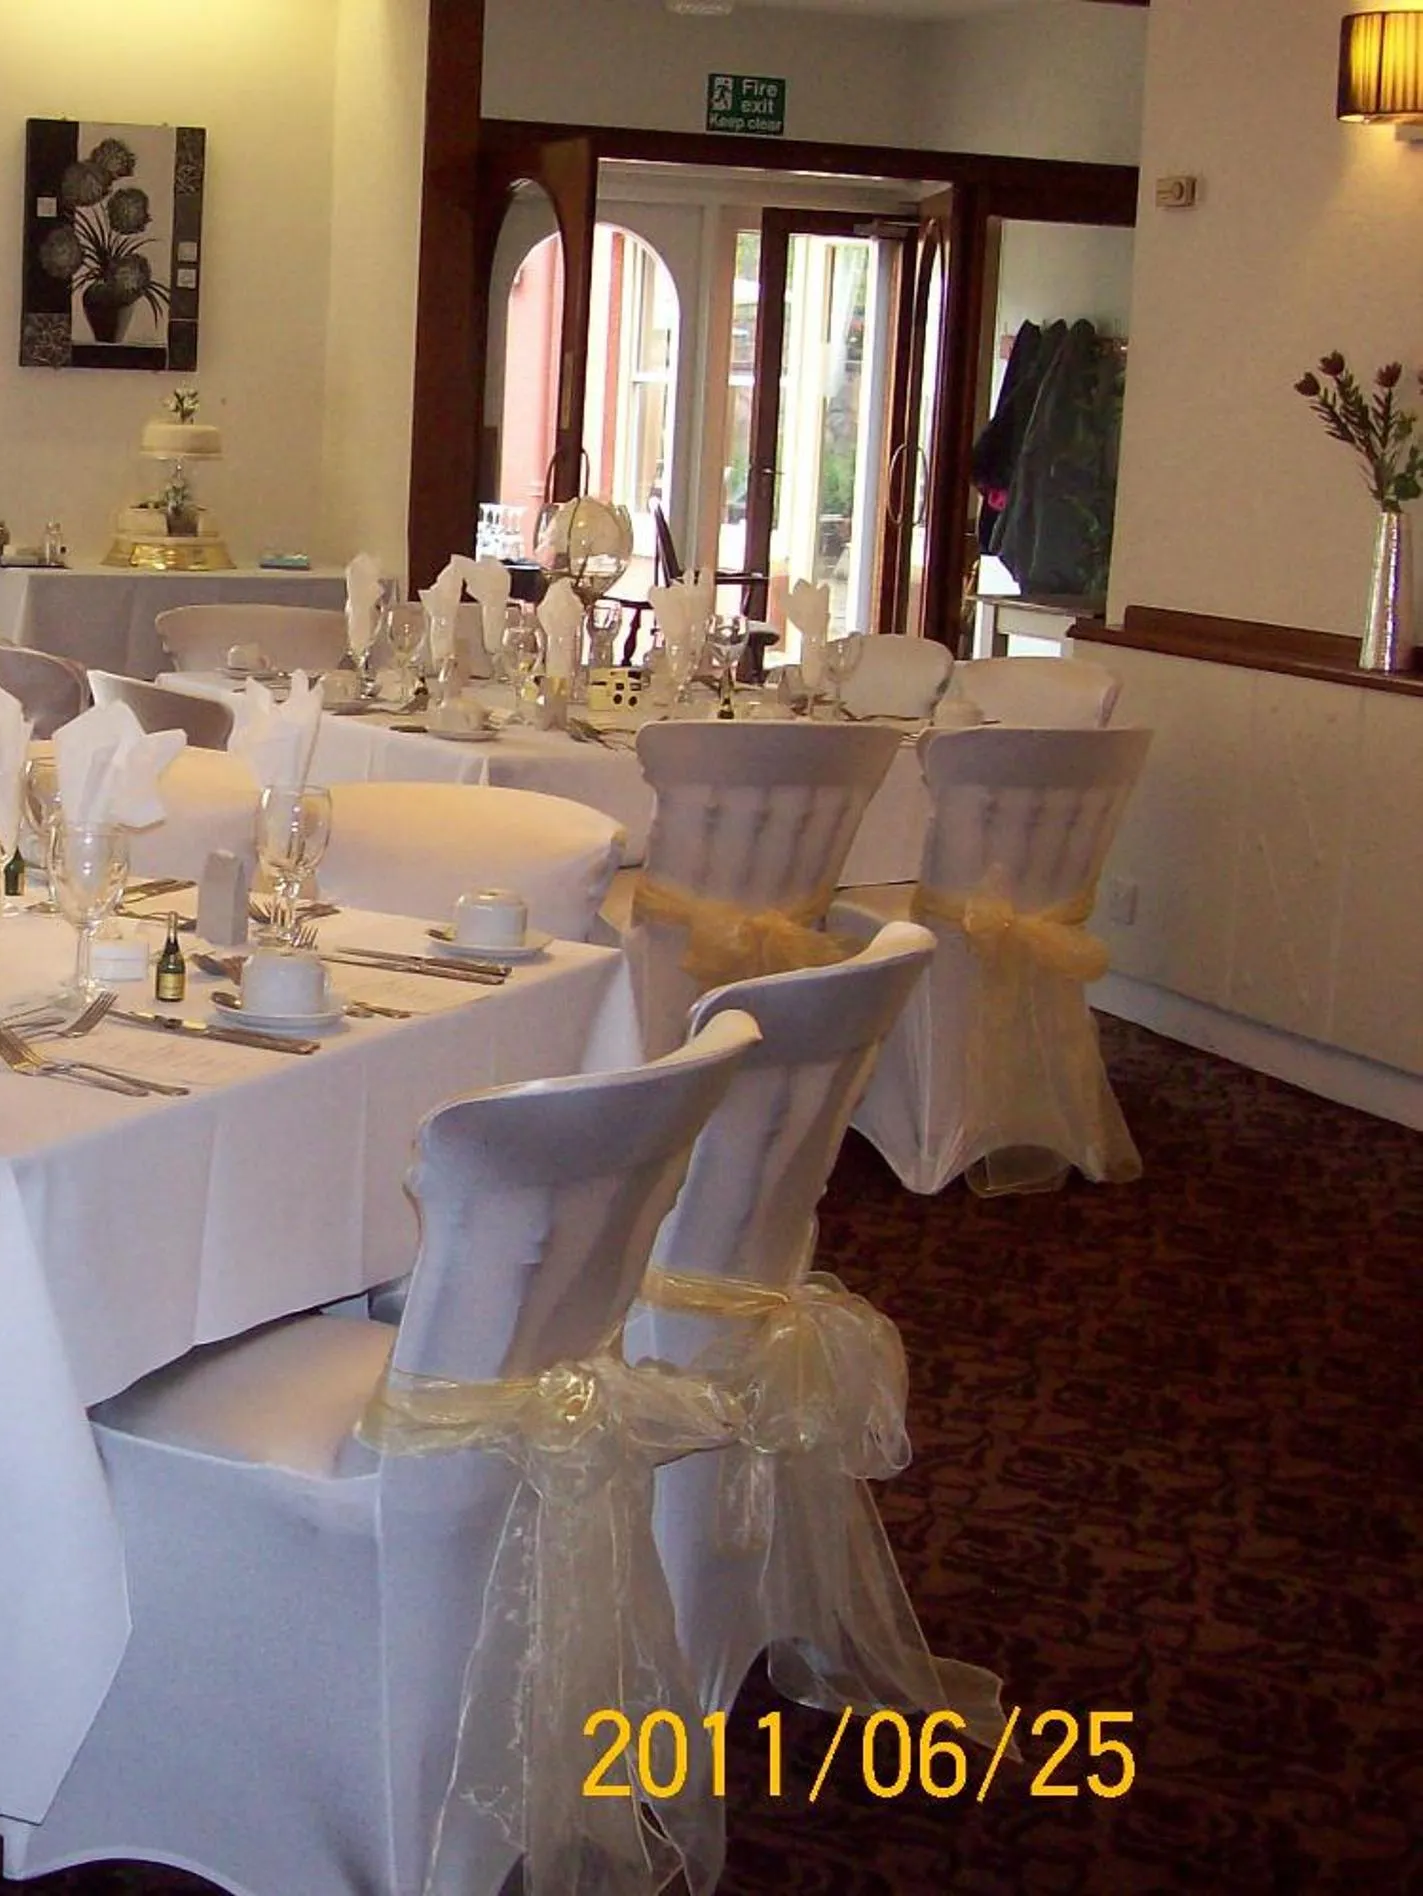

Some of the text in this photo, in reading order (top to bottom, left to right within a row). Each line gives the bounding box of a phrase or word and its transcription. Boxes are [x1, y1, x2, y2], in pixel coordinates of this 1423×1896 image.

[742, 79, 778, 98] Fire
[741, 99, 774, 114] exit
[708, 113, 782, 131] Keep clear
